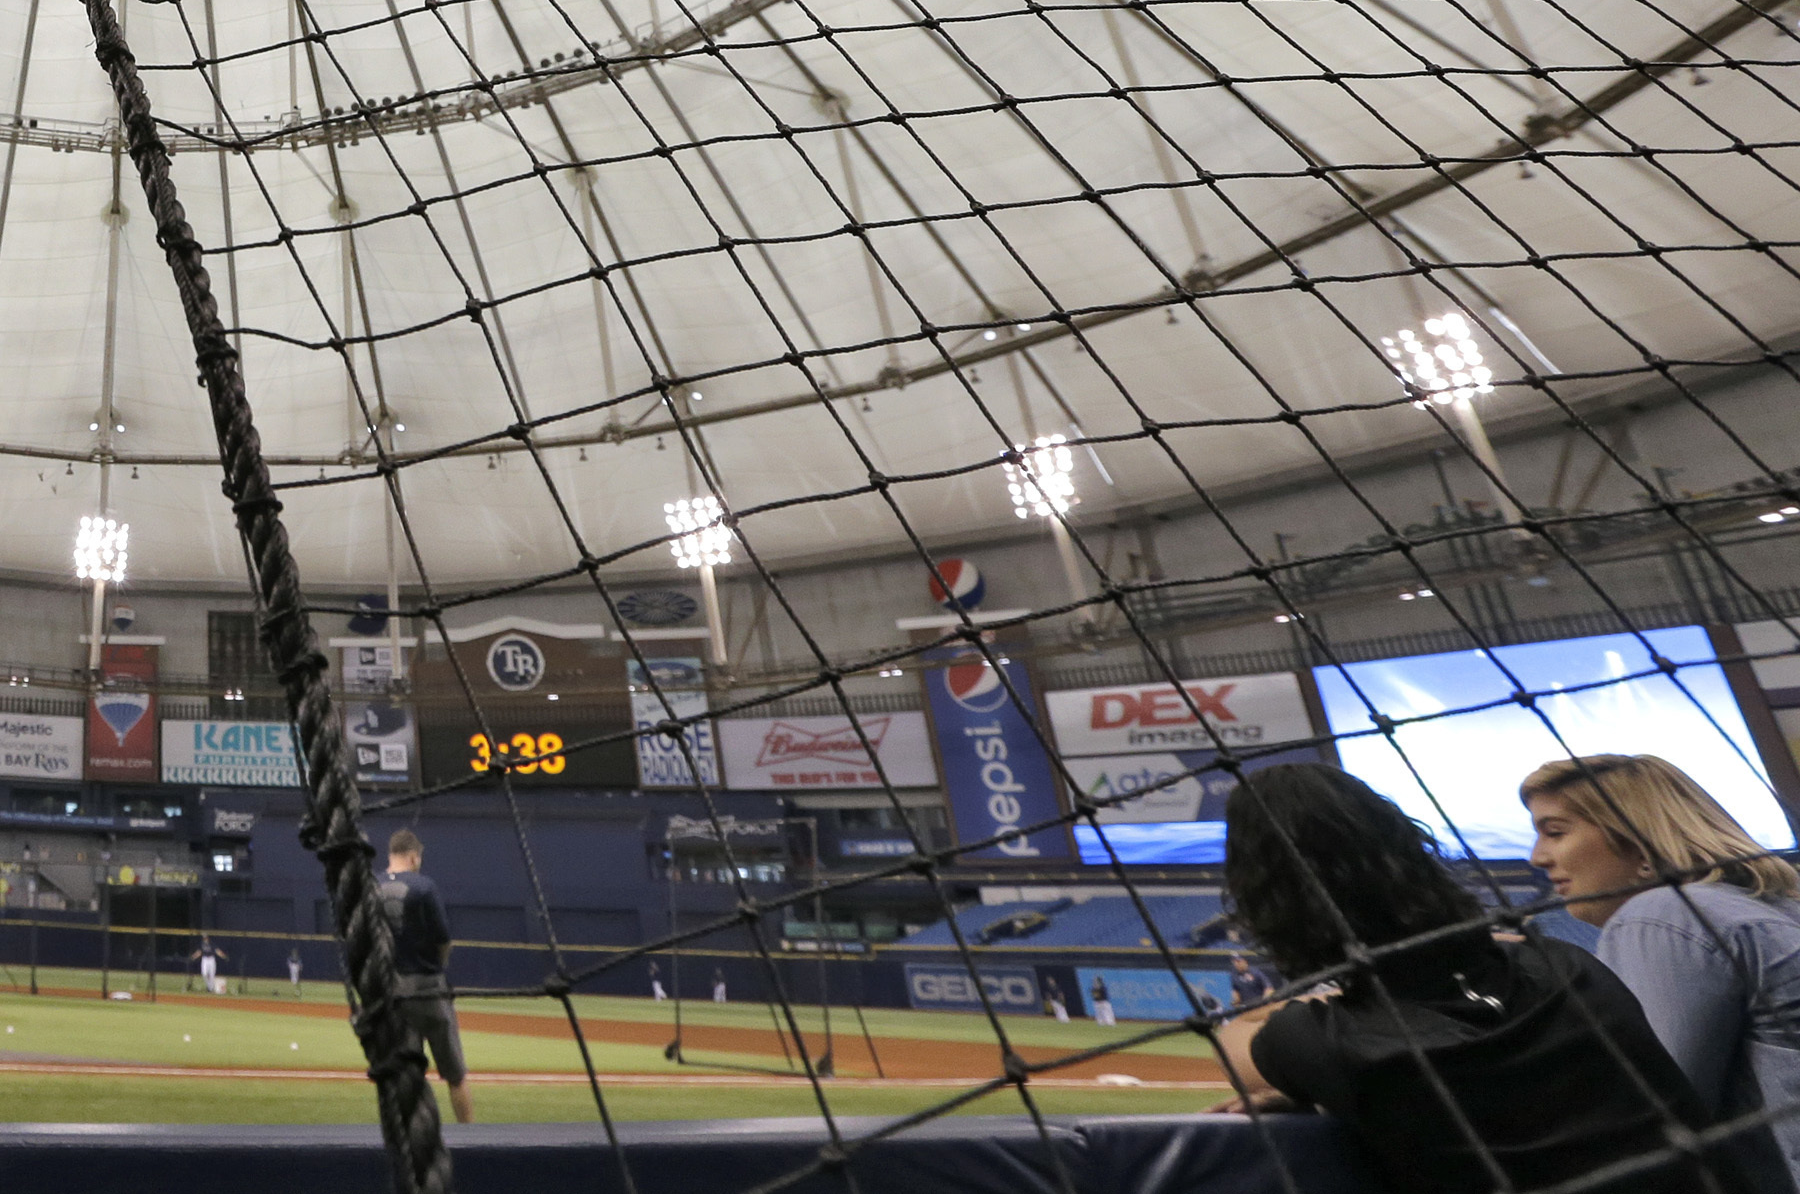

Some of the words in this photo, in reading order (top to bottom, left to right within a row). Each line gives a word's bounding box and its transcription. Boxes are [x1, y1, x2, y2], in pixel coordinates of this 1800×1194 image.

[1091, 684, 1238, 731] DEX
[4, 753, 31, 767] BAY
[470, 732, 566, 774] 3:38
[964, 723, 1040, 857] pepsi
[912, 973, 1037, 1005] GEICO
